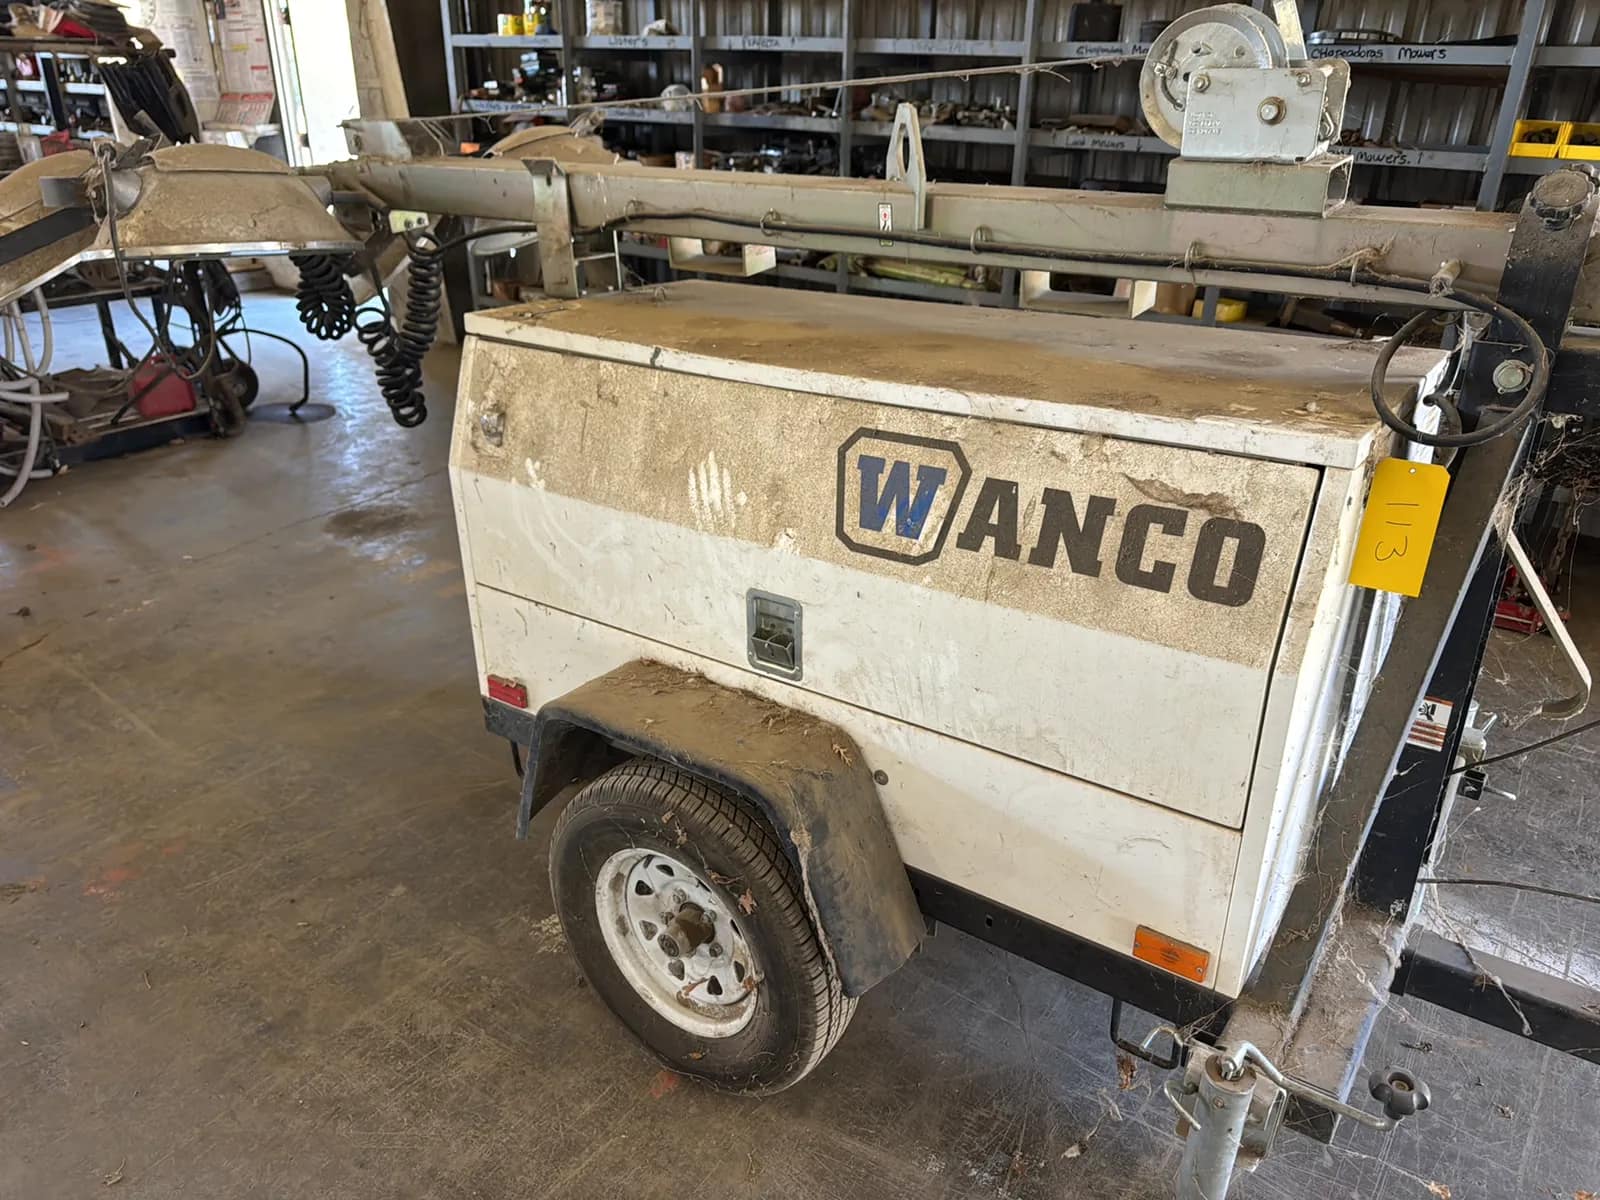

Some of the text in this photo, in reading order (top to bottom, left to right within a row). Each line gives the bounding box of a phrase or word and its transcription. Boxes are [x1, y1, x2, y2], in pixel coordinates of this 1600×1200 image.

[1398, 46, 1447, 60] Mowers
[857, 454, 1267, 608] WANCO
[1374, 502, 1420, 562] 113
